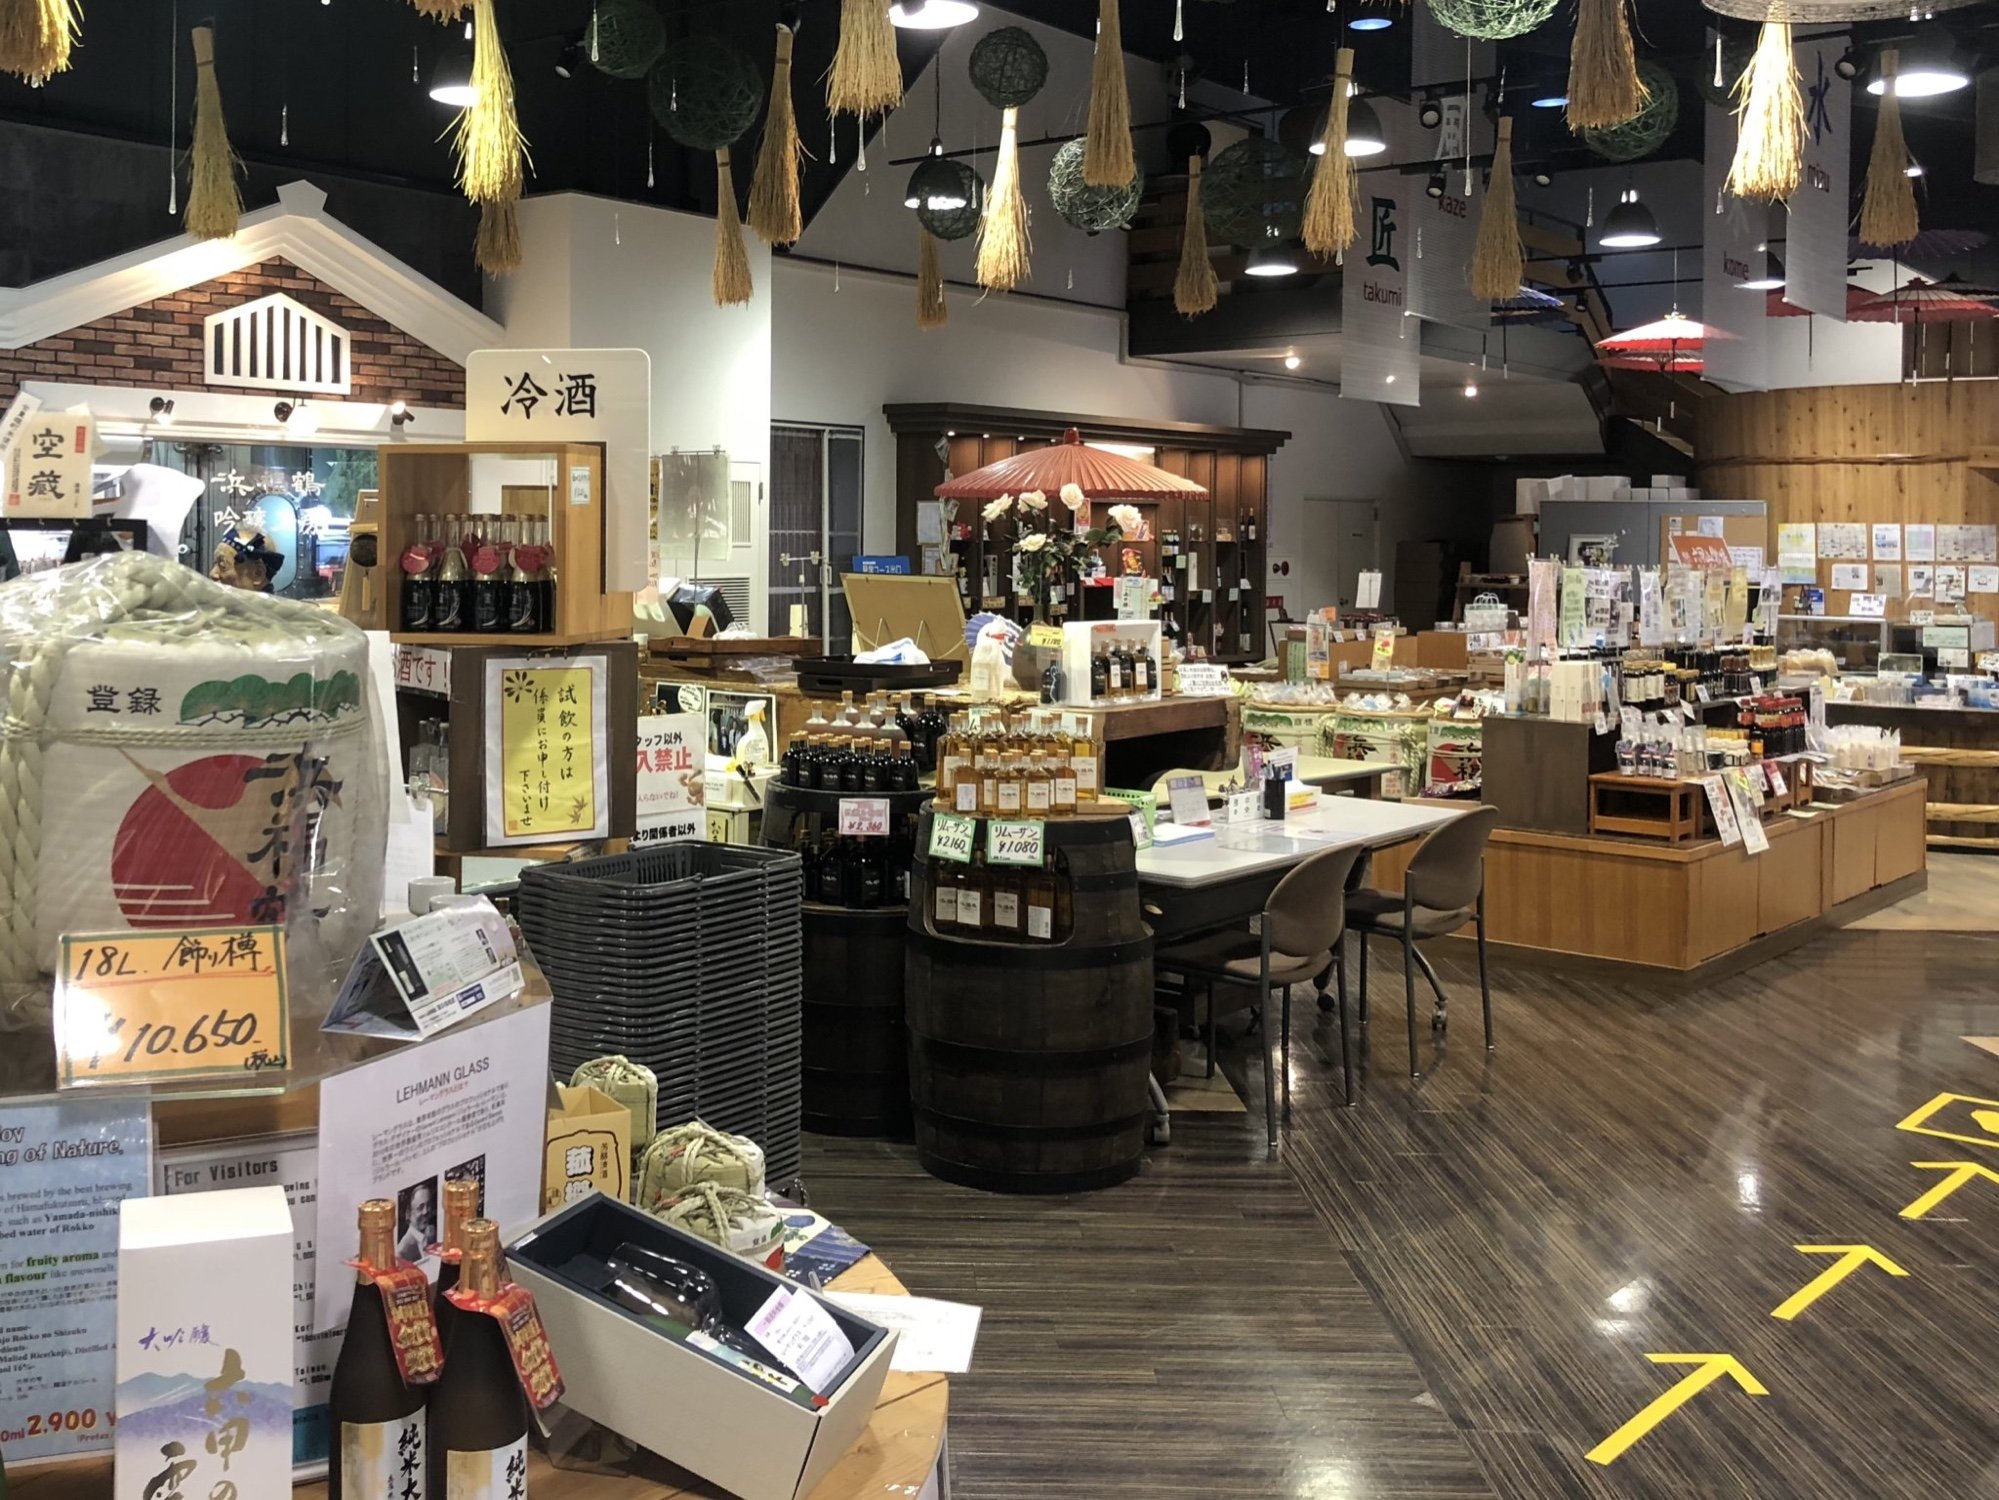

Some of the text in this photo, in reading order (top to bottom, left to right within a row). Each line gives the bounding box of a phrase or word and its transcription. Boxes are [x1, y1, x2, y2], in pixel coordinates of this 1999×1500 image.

[1807, 50, 1832, 146] 水
[1366, 196, 1400, 272] 匠
[1363, 280, 1402, 307] takumi
[501, 372, 596, 420] 冷酒
[86, 685, 162, 716] 登録
[557, 684, 578, 781] 試飲の方は
[519, 769, 533, 827] 下さいませ
[995, 826, 1038, 838] リムーザン
[162, 932, 263, 974] 飾り樽
[396, 1057, 490, 1104] LEHMANN GLASS
[0, 1126, 25, 1144] oy
[24, 1142, 48, 1162] of
[174, 1160, 279, 1187] For Visitors
[43, 1188, 55, 1199] by
[58, 1187, 71, 1196] the
[75, 1185, 93, 1194] best
[8, 1216, 29, 1226] such
[45, 1208, 119, 1222] Yamada-nishik
[19, 1228, 46, 1237] water
[50, 1225, 60, 1234] of
[62, 1222, 95, 1233] Rokko
[26, 1255, 58, 1267] fruity
[61, 1252, 99, 1263] aroma
[5, 1271, 47, 1284] flavour
[27, 1408, 97, 1436] 2.900
